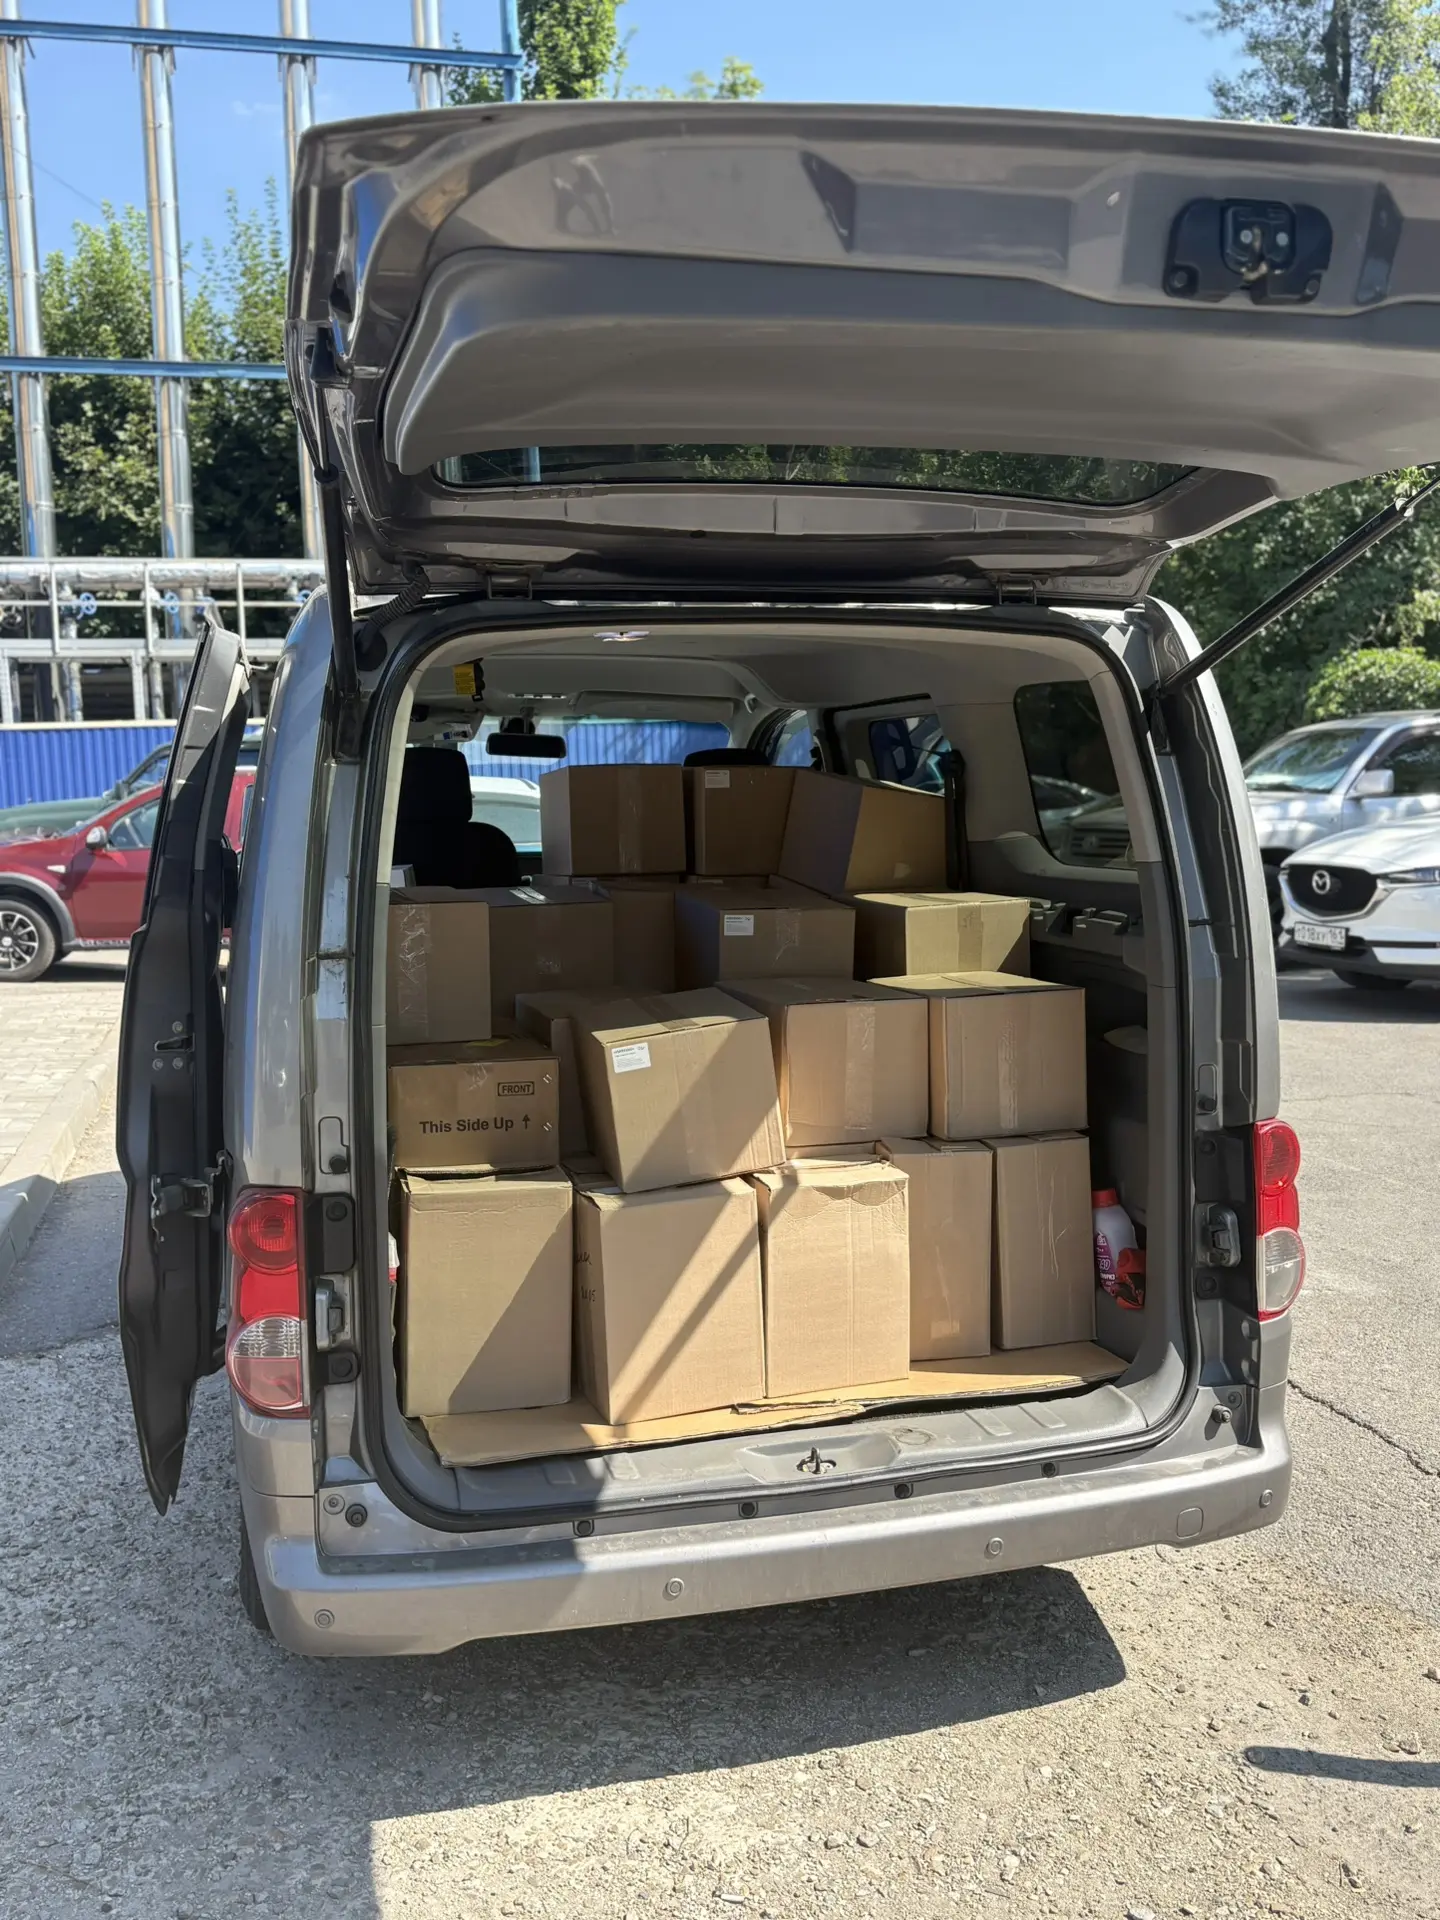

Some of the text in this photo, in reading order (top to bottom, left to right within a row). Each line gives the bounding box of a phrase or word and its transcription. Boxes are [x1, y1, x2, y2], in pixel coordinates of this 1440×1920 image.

[502, 1084, 532, 1094] FRONT
[419, 1116, 514, 1134] This Side Up
